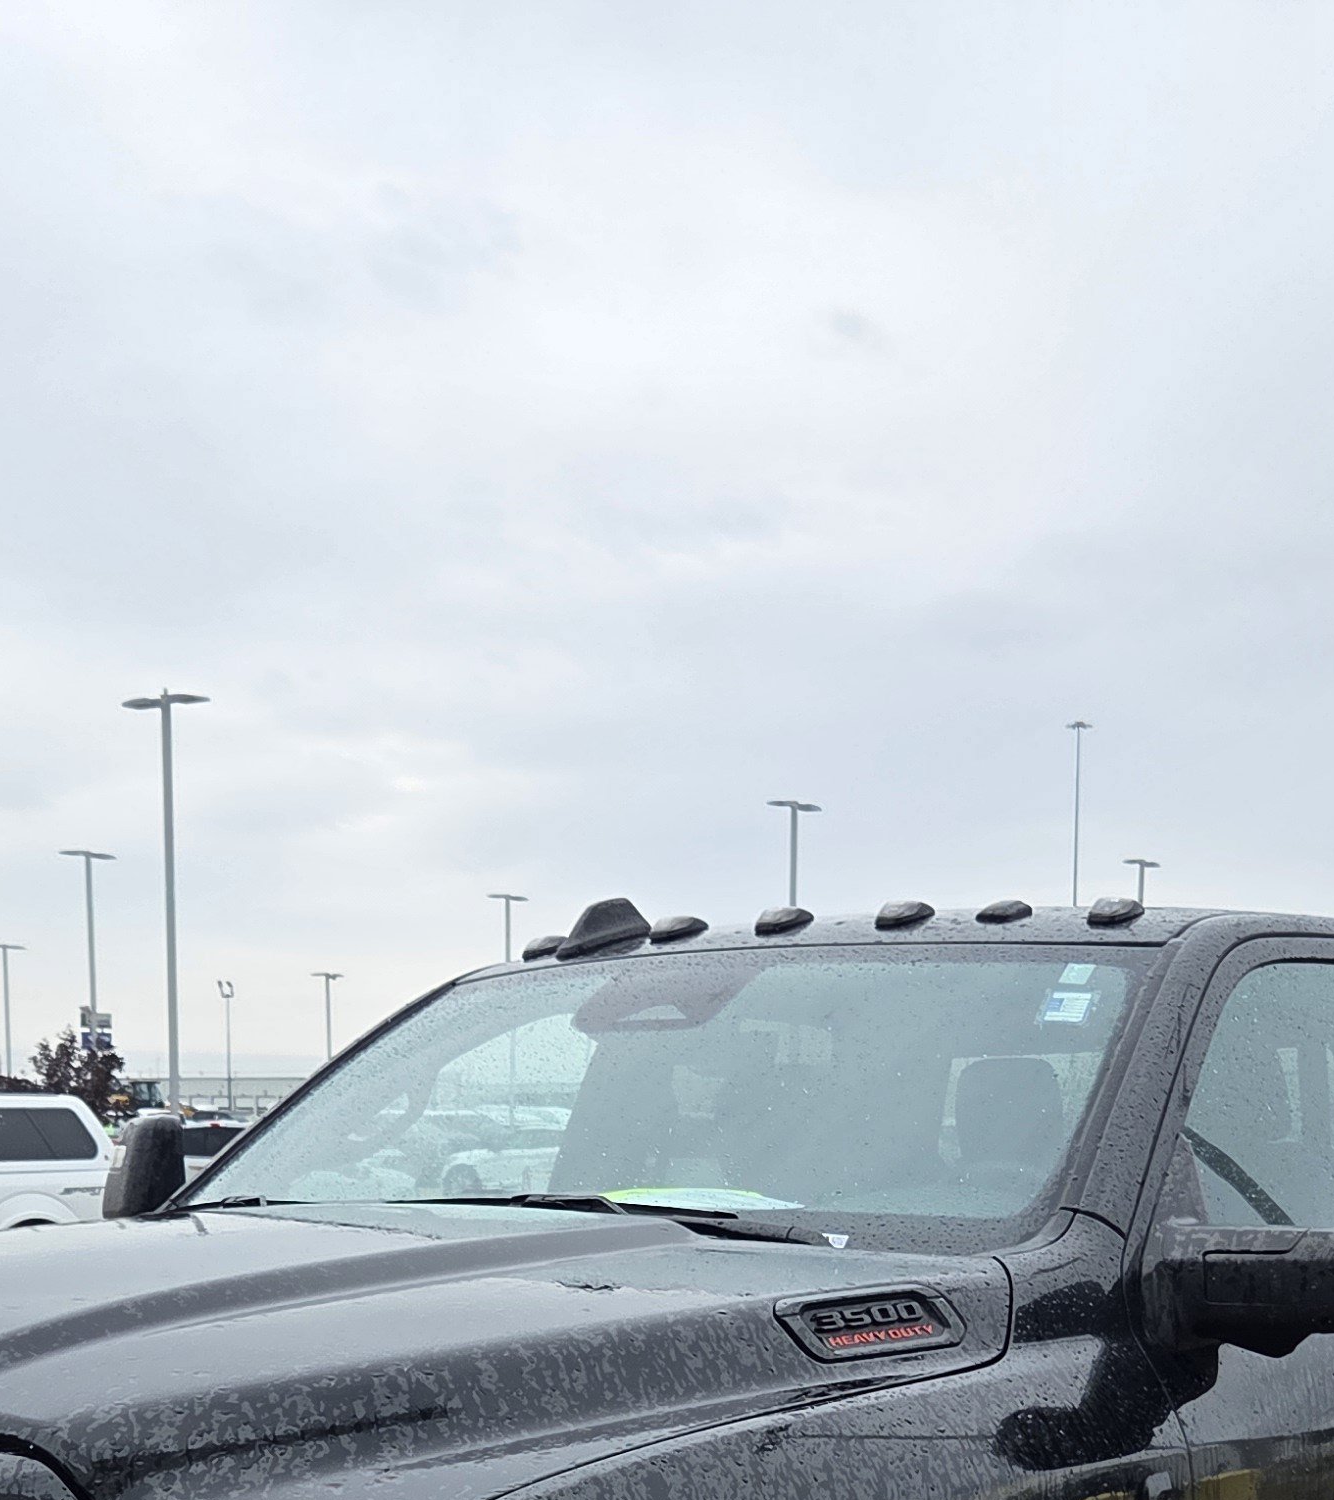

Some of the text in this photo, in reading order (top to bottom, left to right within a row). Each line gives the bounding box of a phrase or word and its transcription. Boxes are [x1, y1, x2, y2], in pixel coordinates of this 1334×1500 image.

[814, 1301, 924, 1331] 3500
[828, 1324, 934, 1347] HEAVY DUTY
